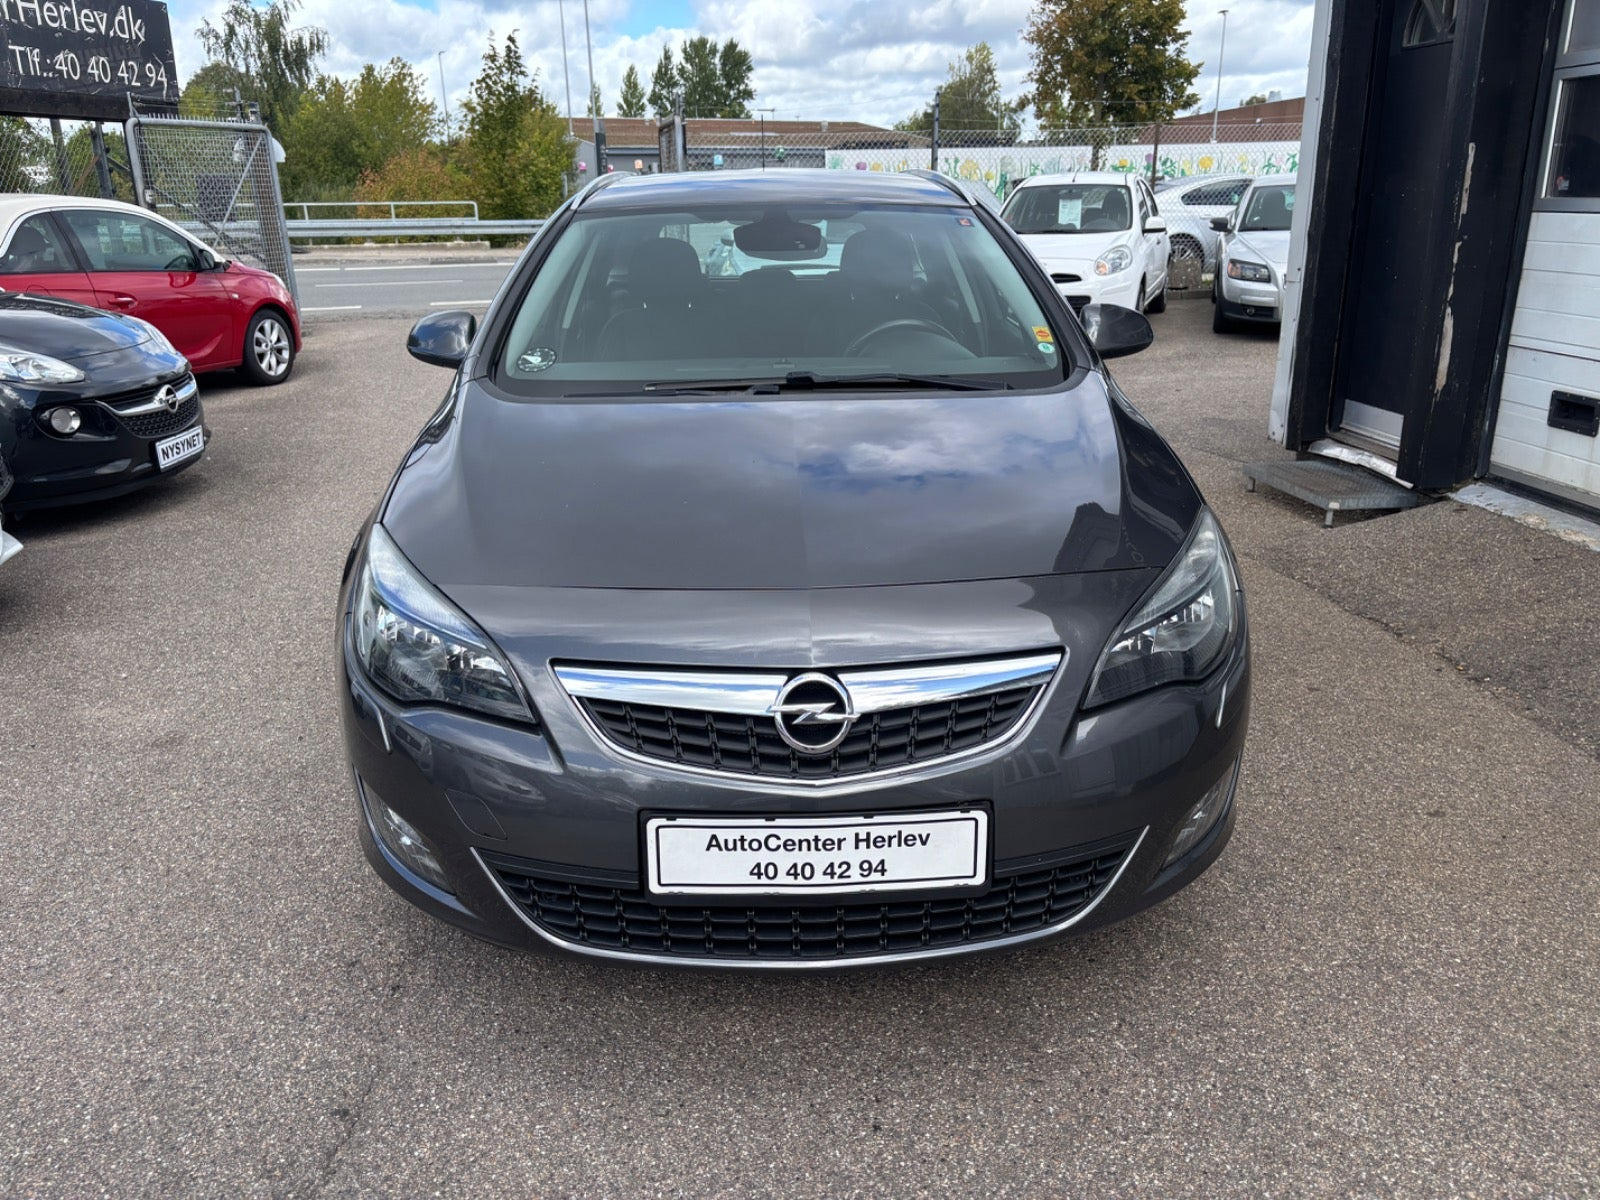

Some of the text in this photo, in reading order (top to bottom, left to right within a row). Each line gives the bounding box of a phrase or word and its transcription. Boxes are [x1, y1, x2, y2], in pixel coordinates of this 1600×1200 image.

[0, 0, 146, 43] rHerlev.dk
[87, 55, 111, 84] 40
[117, 60, 141, 87] 42
[145, 63, 168, 100] 94
[161, 432, 201, 461] NYSYNET
[705, 829, 931, 852] AutoCenter Herlev
[749, 859, 888, 881] 40 40 42 94
